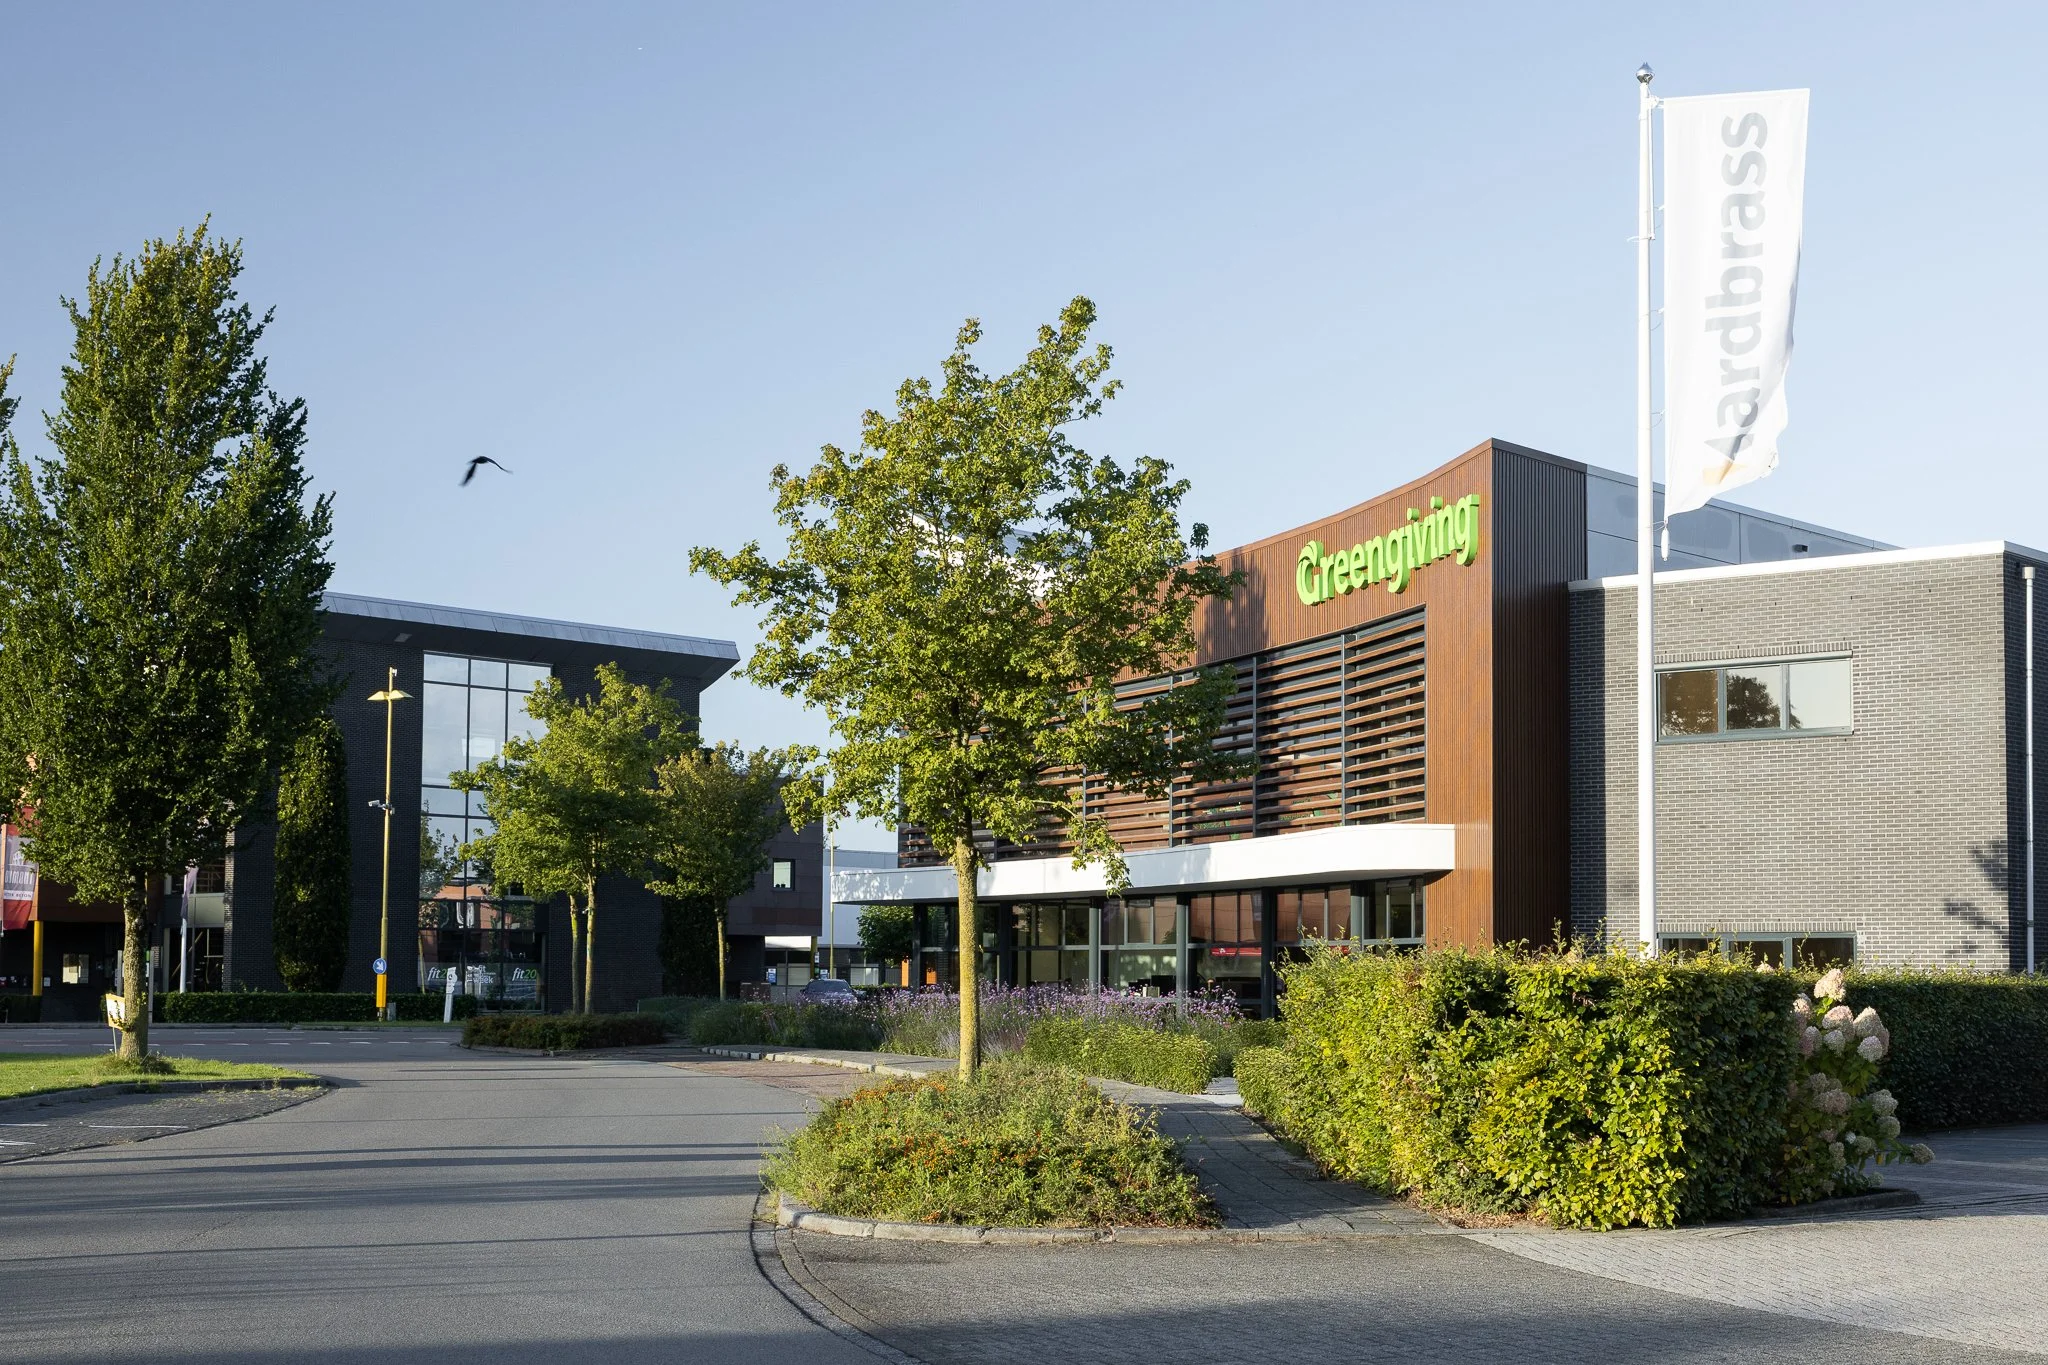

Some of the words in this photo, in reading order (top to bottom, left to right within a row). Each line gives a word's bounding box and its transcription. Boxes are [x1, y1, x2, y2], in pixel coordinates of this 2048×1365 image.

[1296, 494, 1480, 606] Greengiving
[428, 967, 447, 981] fit2
[512, 967, 537, 981] fit20
